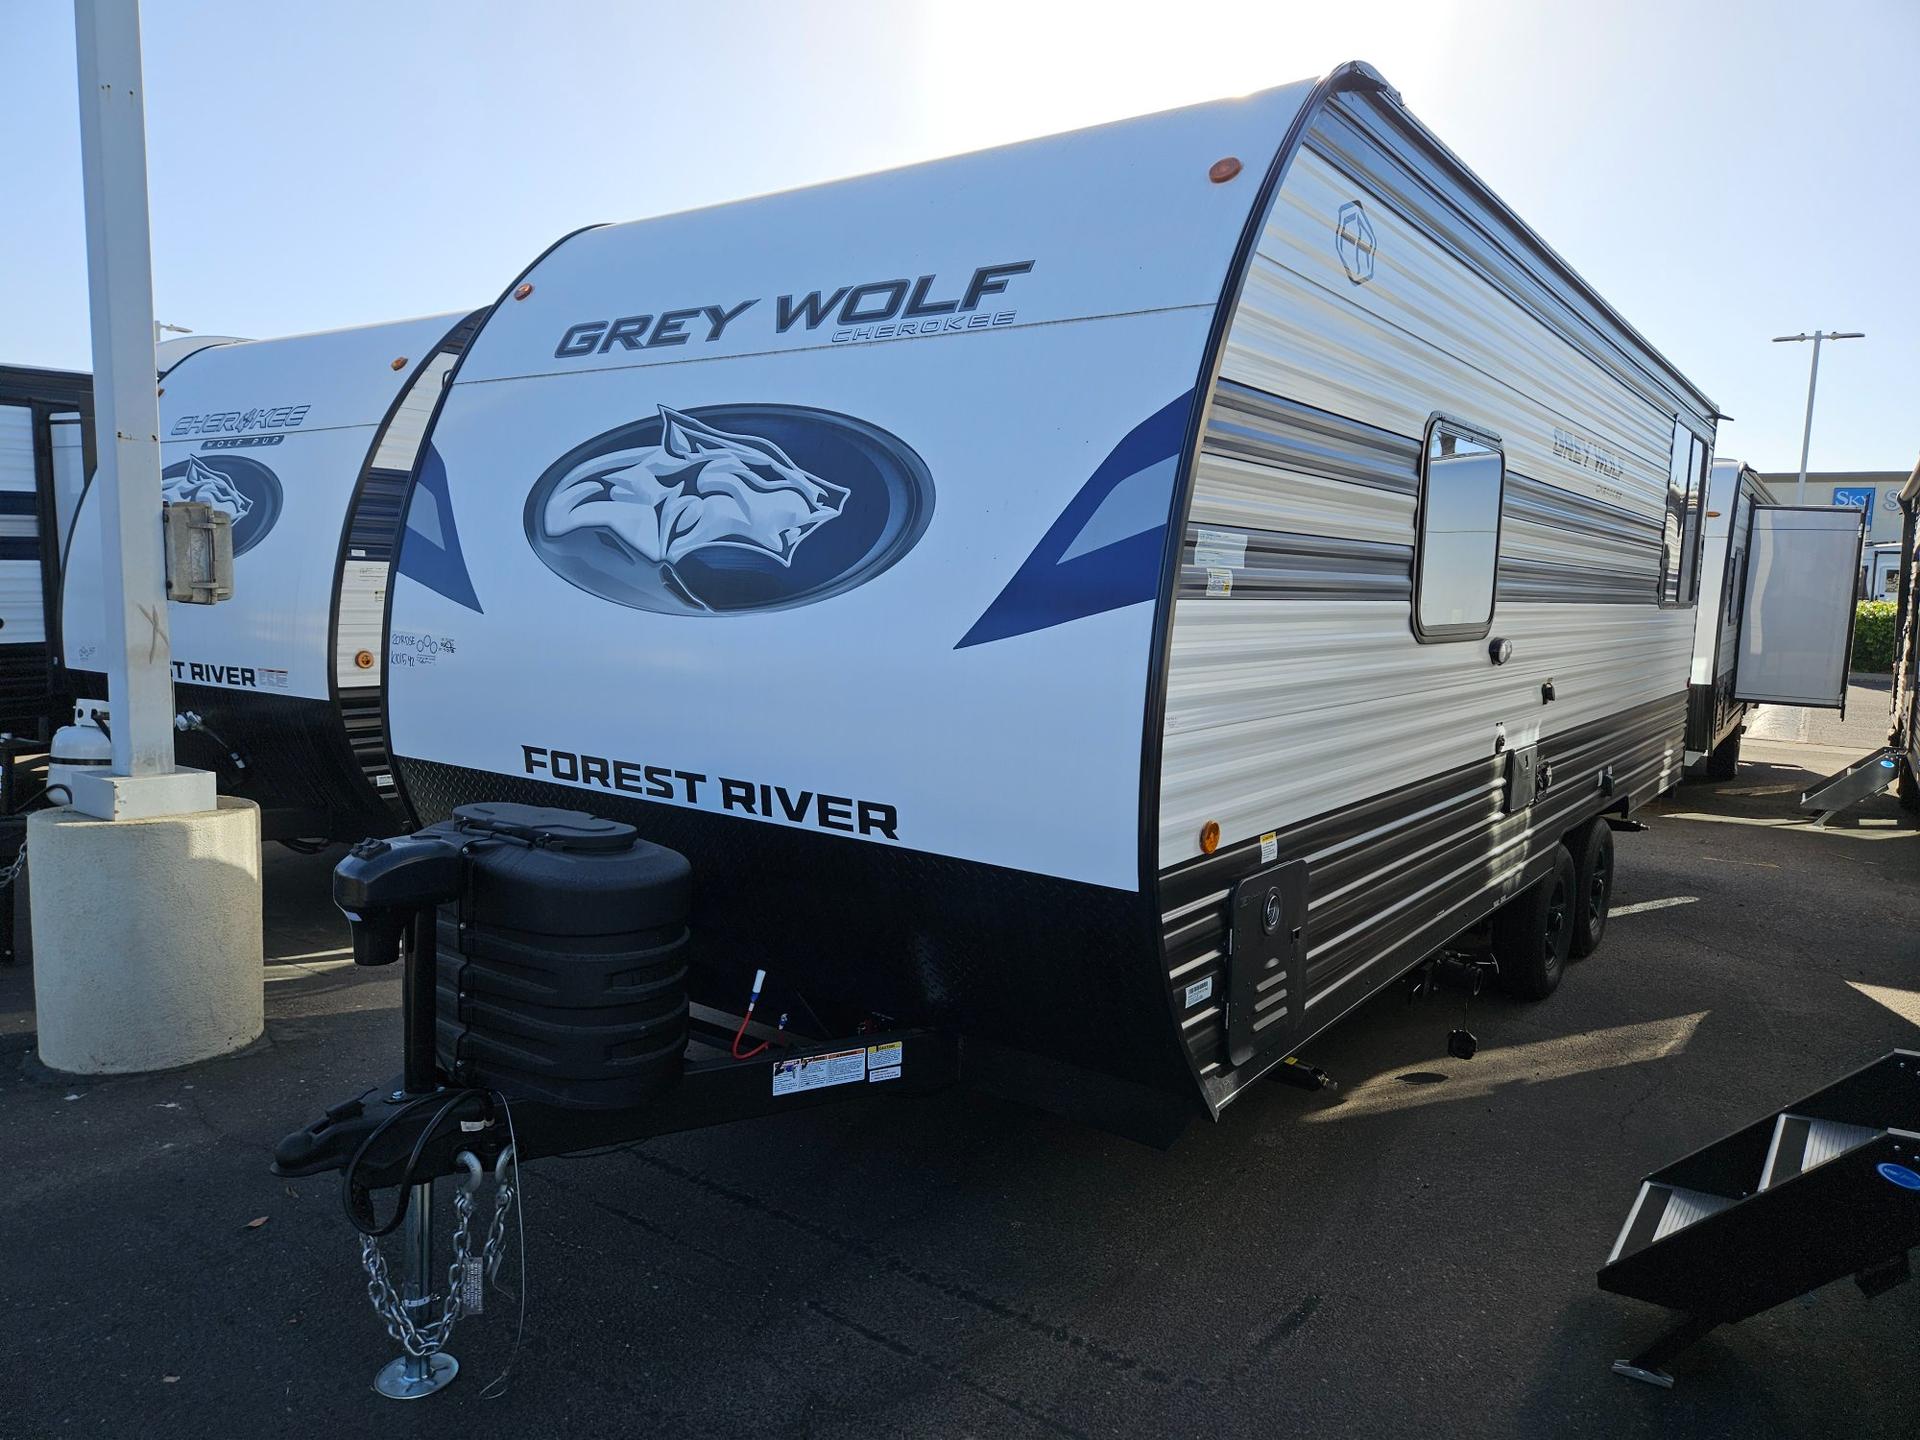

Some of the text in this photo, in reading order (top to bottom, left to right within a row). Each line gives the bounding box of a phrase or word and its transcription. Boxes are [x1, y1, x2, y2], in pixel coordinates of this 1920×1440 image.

[554, 260, 1036, 359] GREY WOLF
[832, 310, 1017, 343] CHEROKEE
[206, 436, 280, 448] WOLF PUP
[1553, 428, 1624, 481] GREY WOLF
[189, 662, 256, 688] RIVER
[521, 744, 899, 841] FOREST RIVER
